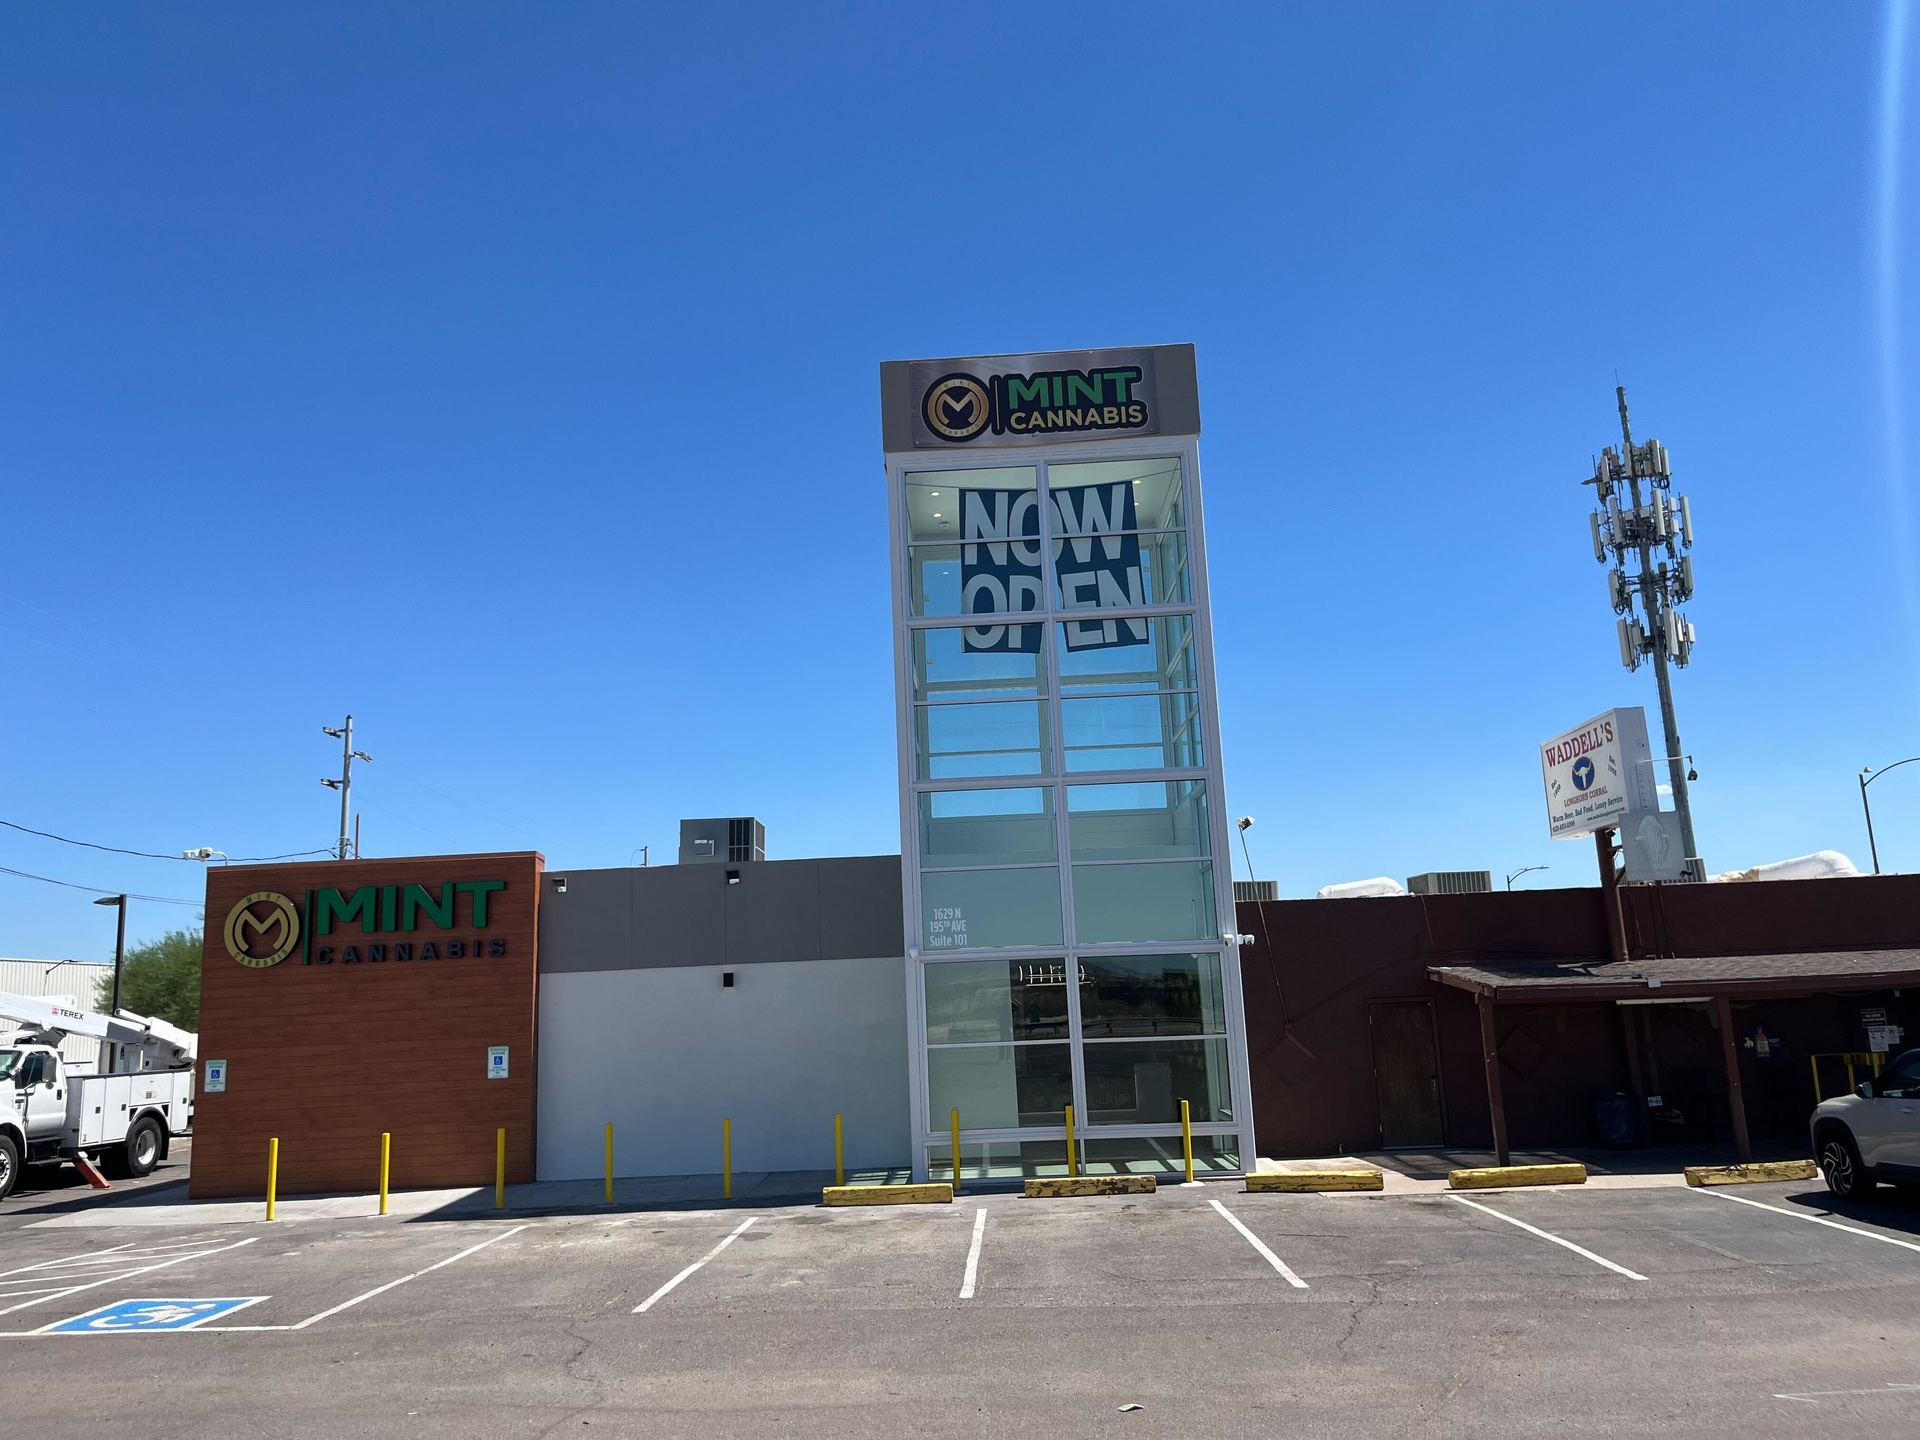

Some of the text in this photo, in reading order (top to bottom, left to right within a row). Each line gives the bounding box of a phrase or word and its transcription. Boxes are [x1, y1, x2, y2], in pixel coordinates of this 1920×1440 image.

[1008, 371, 1137, 410] MINT
[1009, 404, 1144, 430] CANNABIS
[964, 484, 1126, 567] NOW
[962, 566, 1148, 649] OPEN
[1545, 721, 1614, 768] WADDELL'S
[1588, 785, 1608, 799] CORRAL
[1607, 795, 1623, 806] Service
[245, 892, 281, 904] MINT
[316, 880, 506, 935] MINT
[933, 907, 961, 920] 1629 N
[951, 920, 967, 932] AVE
[929, 934, 968, 947] Suite 101
[234, 948, 288, 967] CANNABIS
[315, 938, 506, 965] CANNABIS
[60, 1008, 85, 1020] TEREX
